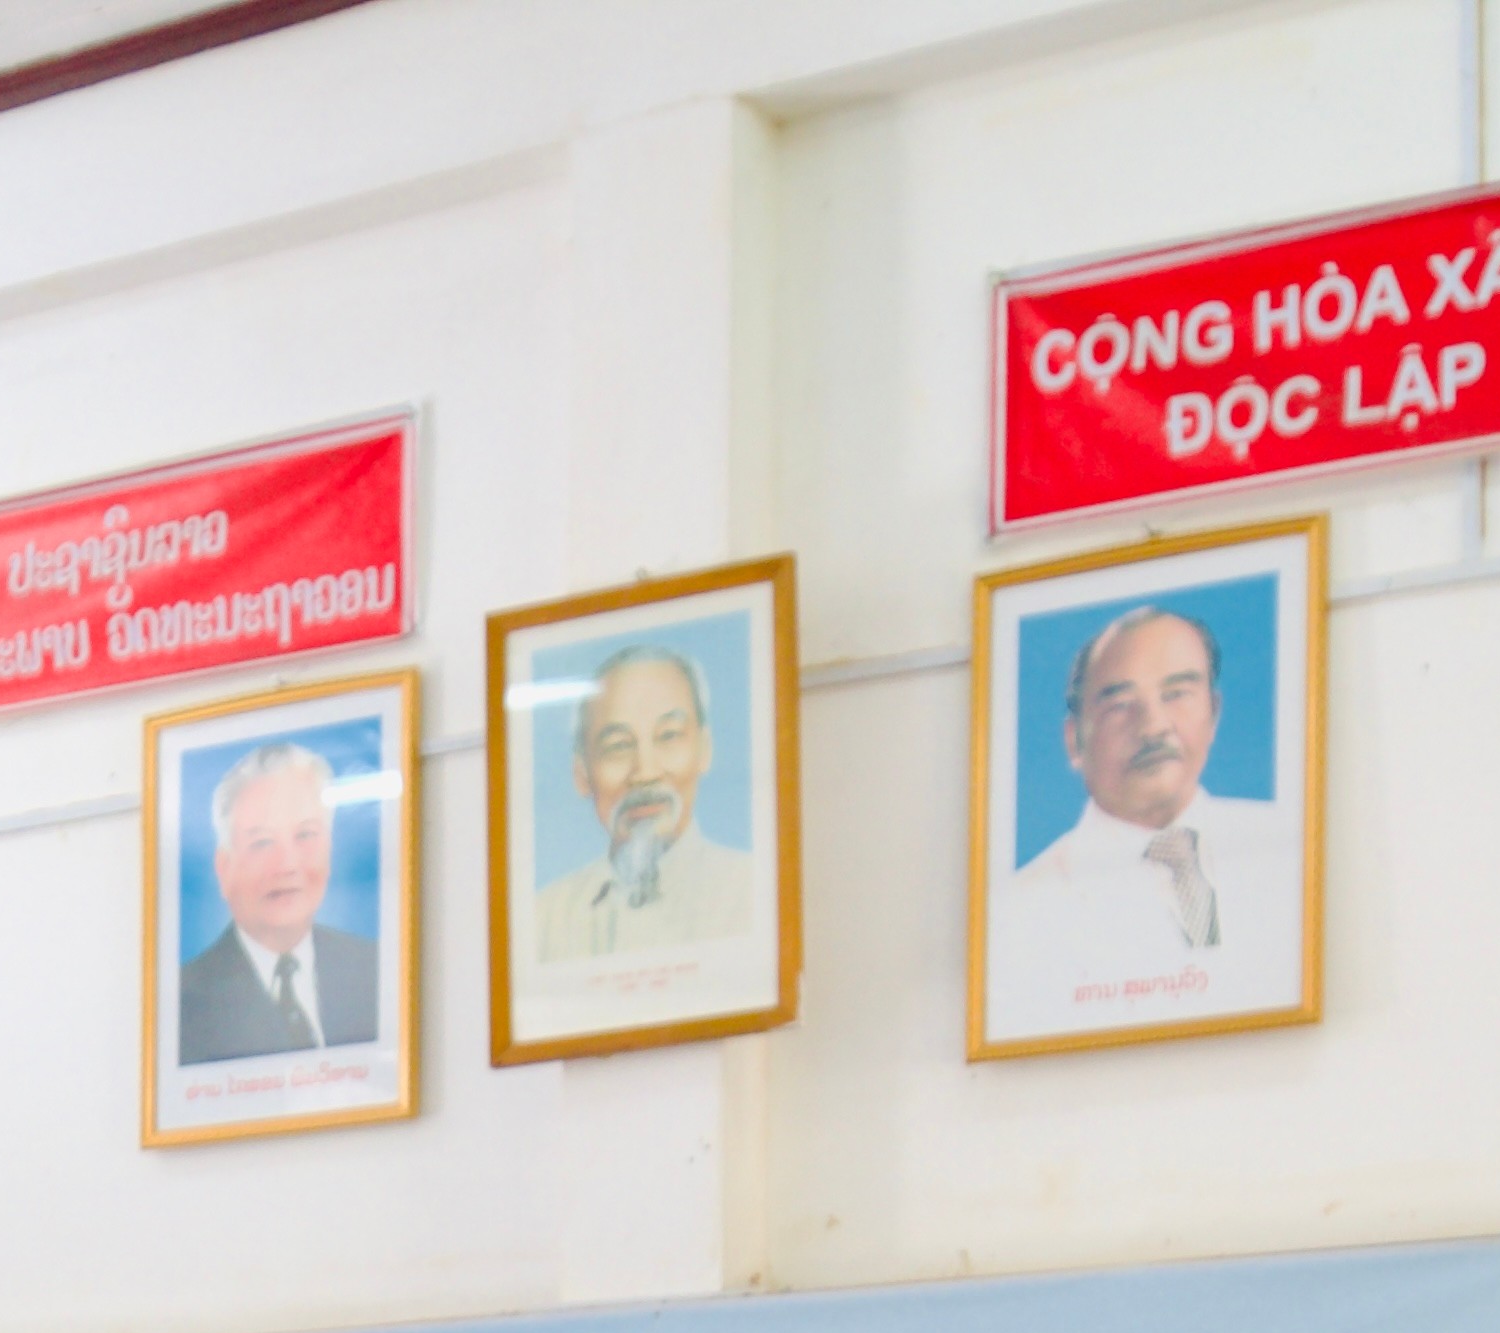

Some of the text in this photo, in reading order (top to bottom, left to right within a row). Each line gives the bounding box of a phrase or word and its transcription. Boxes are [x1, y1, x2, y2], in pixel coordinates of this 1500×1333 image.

[1032, 301, 1234, 392] CỘNG
[1253, 262, 1409, 352] HÒA
[1165, 374, 1319, 457] ĐỘC
[1341, 341, 1485, 430] LẬP
